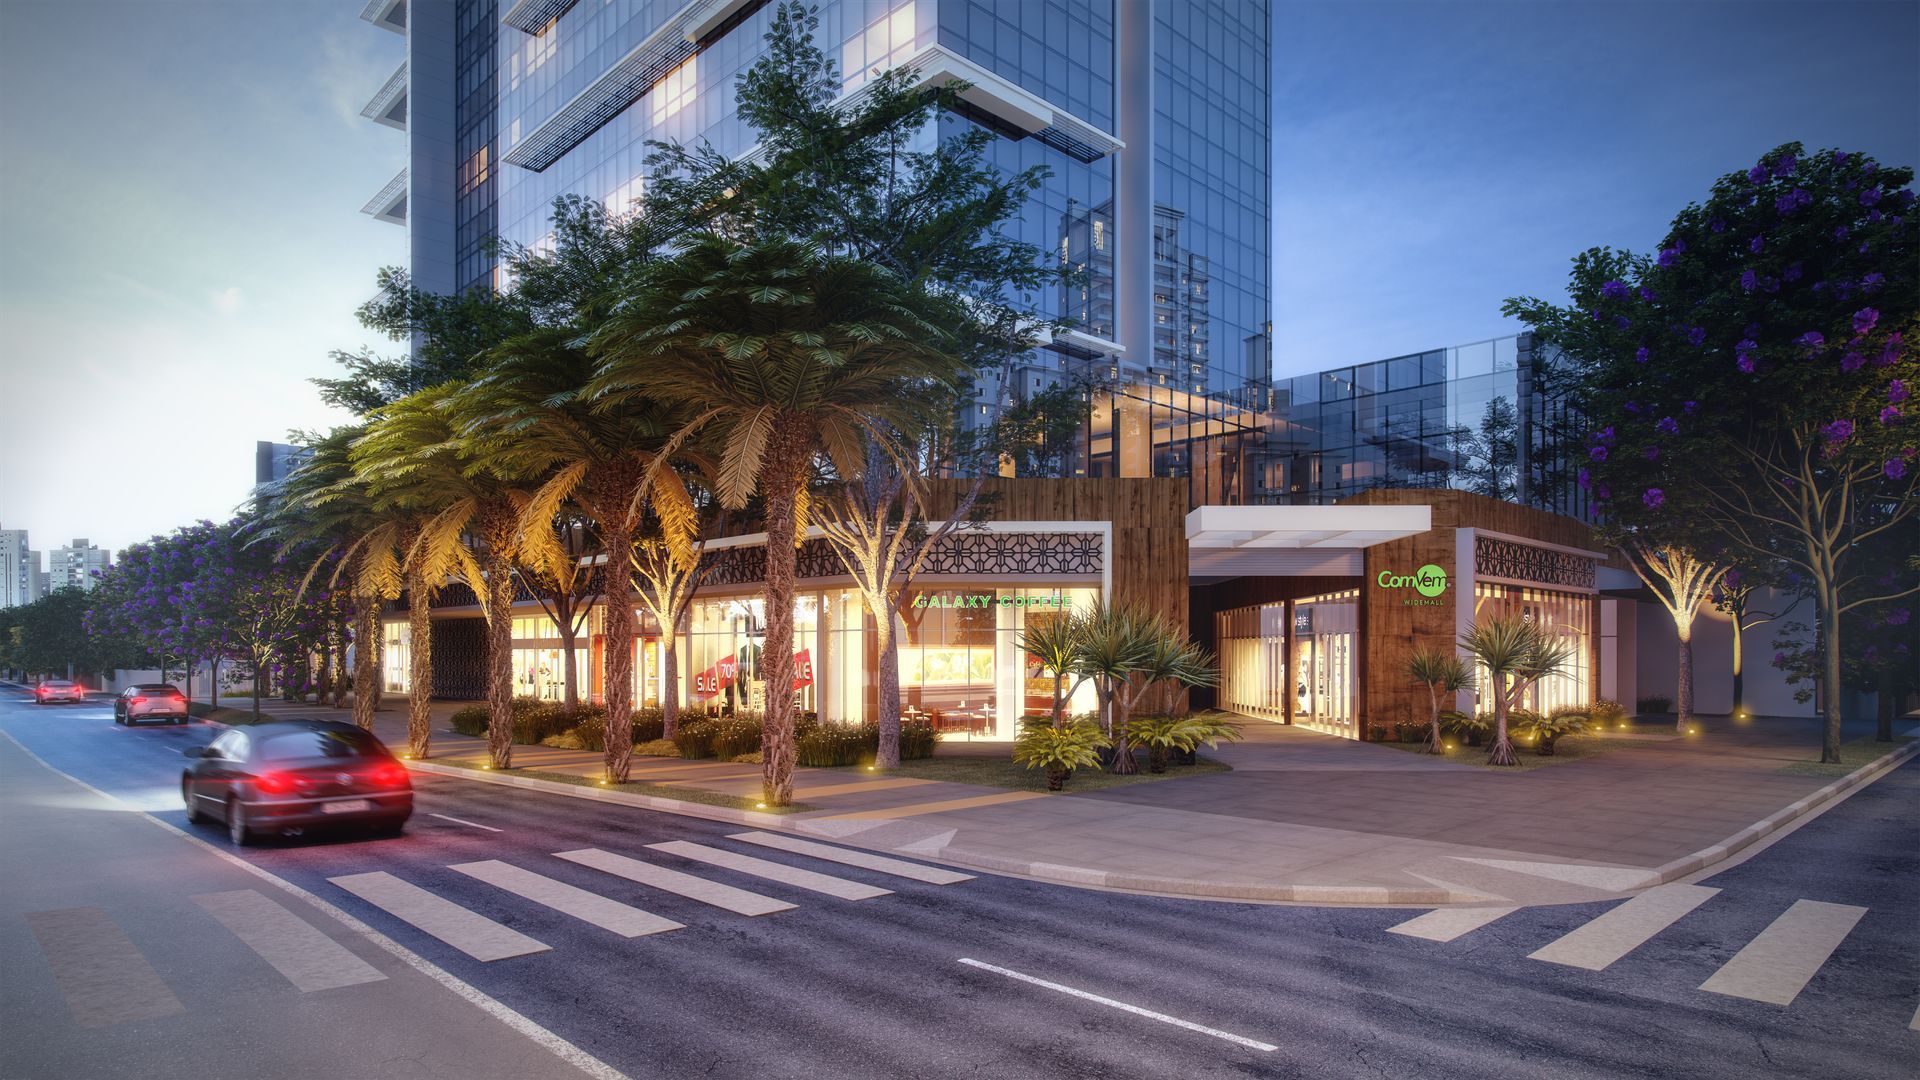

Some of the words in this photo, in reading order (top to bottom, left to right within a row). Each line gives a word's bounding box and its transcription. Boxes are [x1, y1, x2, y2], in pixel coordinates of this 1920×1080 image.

[1377, 570, 1448, 588] ComVem
[915, 595, 991, 609] GALAXY
[1000, 595, 1073, 609] COFFEE
[697, 677, 716, 691] SLE
